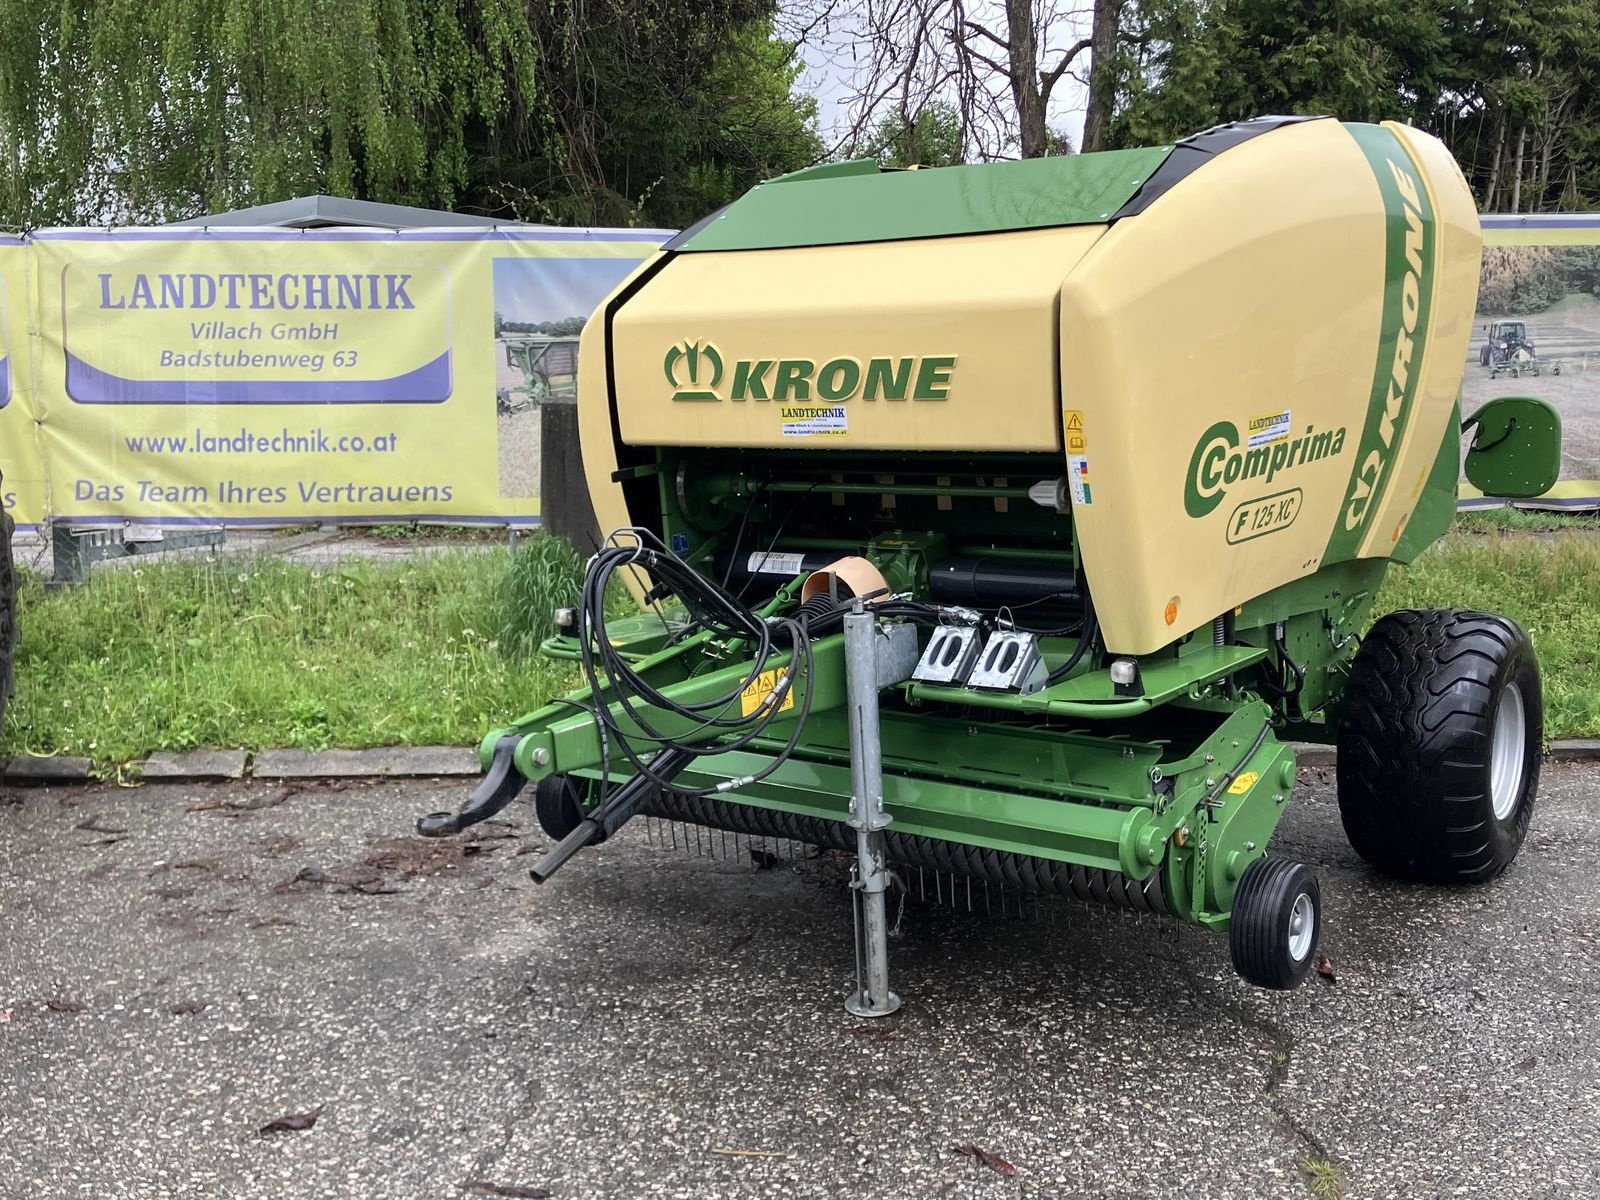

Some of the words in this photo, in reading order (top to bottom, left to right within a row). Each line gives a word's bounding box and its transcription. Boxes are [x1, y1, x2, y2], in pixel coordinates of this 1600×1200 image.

[98, 273, 415, 310] LANDTECHNIK
[1379, 158, 1424, 451] KRONE
[190, 322, 262, 340] Villach
[270, 323, 338, 340] GmbH
[160, 350, 324, 371] Badstubenweg
[332, 350, 358, 368] 63
[730, 354, 958, 402] KRONE
[781, 408, 845, 418] LANDTECHNIK
[125, 428, 397, 453] www.landtechnik.co.at
[1184, 421, 1346, 518] Comprima
[75, 479, 125, 502] Das
[137, 480, 208, 503] Team
[219, 480, 287, 503] Ihres
[298, 481, 453, 503] Vertrauens
[1234, 511, 1248, 535] F
[1251, 503, 1276, 530] 125
[1274, 497, 1295, 524] XC
